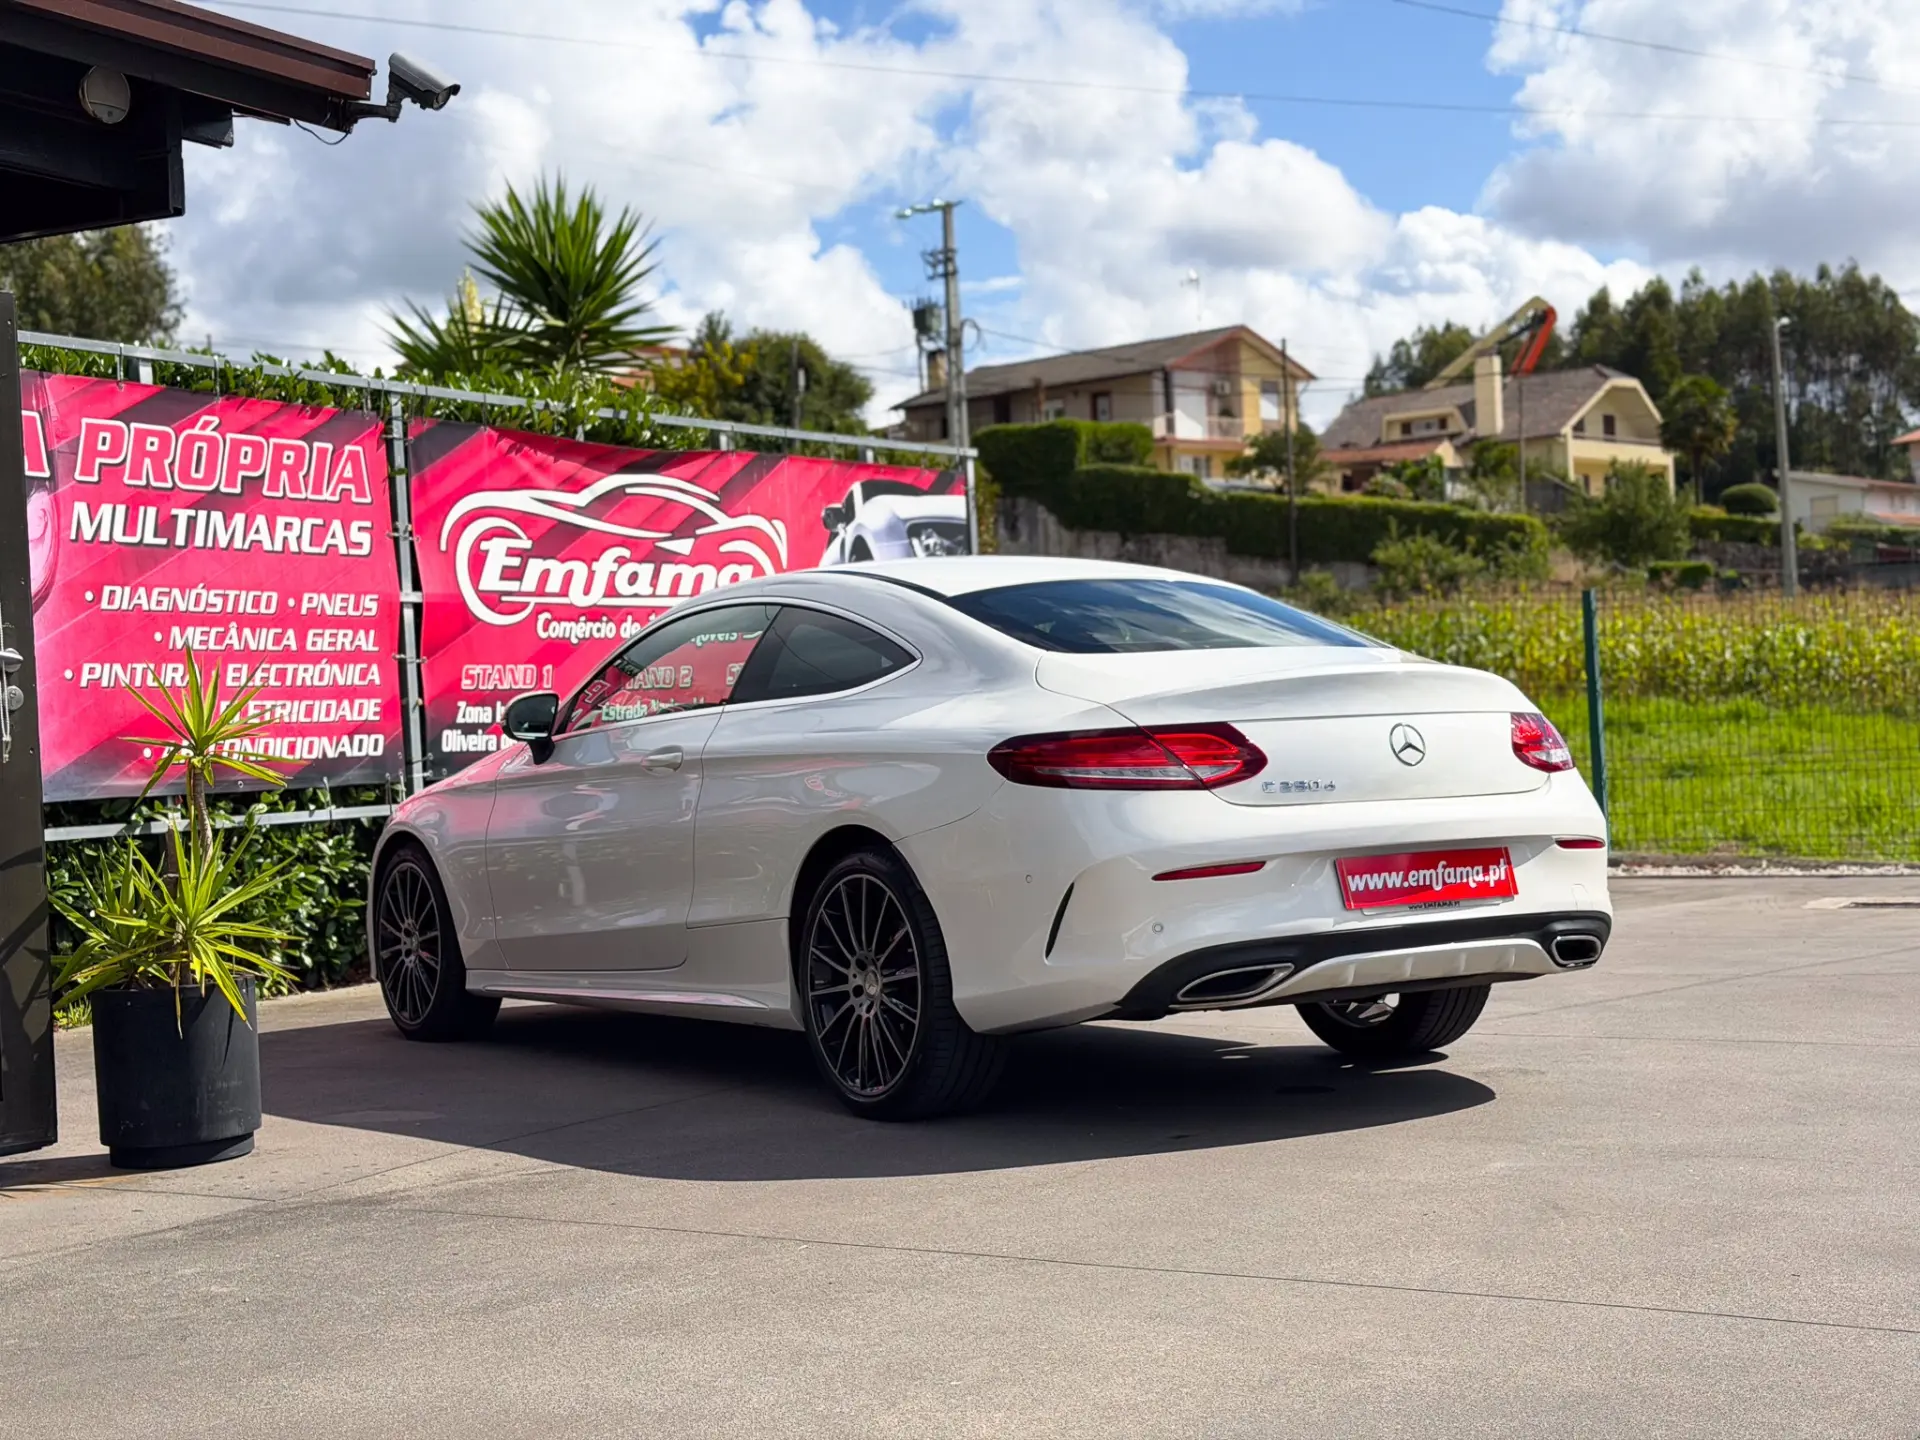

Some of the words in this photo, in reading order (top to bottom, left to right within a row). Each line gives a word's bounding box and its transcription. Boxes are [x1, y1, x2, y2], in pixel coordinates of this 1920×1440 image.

[75, 416, 372, 504] PRÓPRIA
[70, 501, 372, 556] MULTIMARCAS
[477, 538, 753, 606] Emfama
[100, 583, 278, 614] DIAGNÓSTICO
[300, 592, 379, 617] PNEUS
[169, 622, 298, 652] MECÂNICA
[305, 628, 380, 653] GERAL
[537, 612, 616, 644] Comércio
[225, 658, 381, 688] ELECTRÓNICA
[461, 665, 538, 690] STAND
[542, 665, 553, 689] 1
[679, 665, 693, 688] 2
[456, 701, 493, 724] Zona
[441, 729, 498, 752] Oliveira
[1347, 858, 1509, 892] www.emfama.pt
